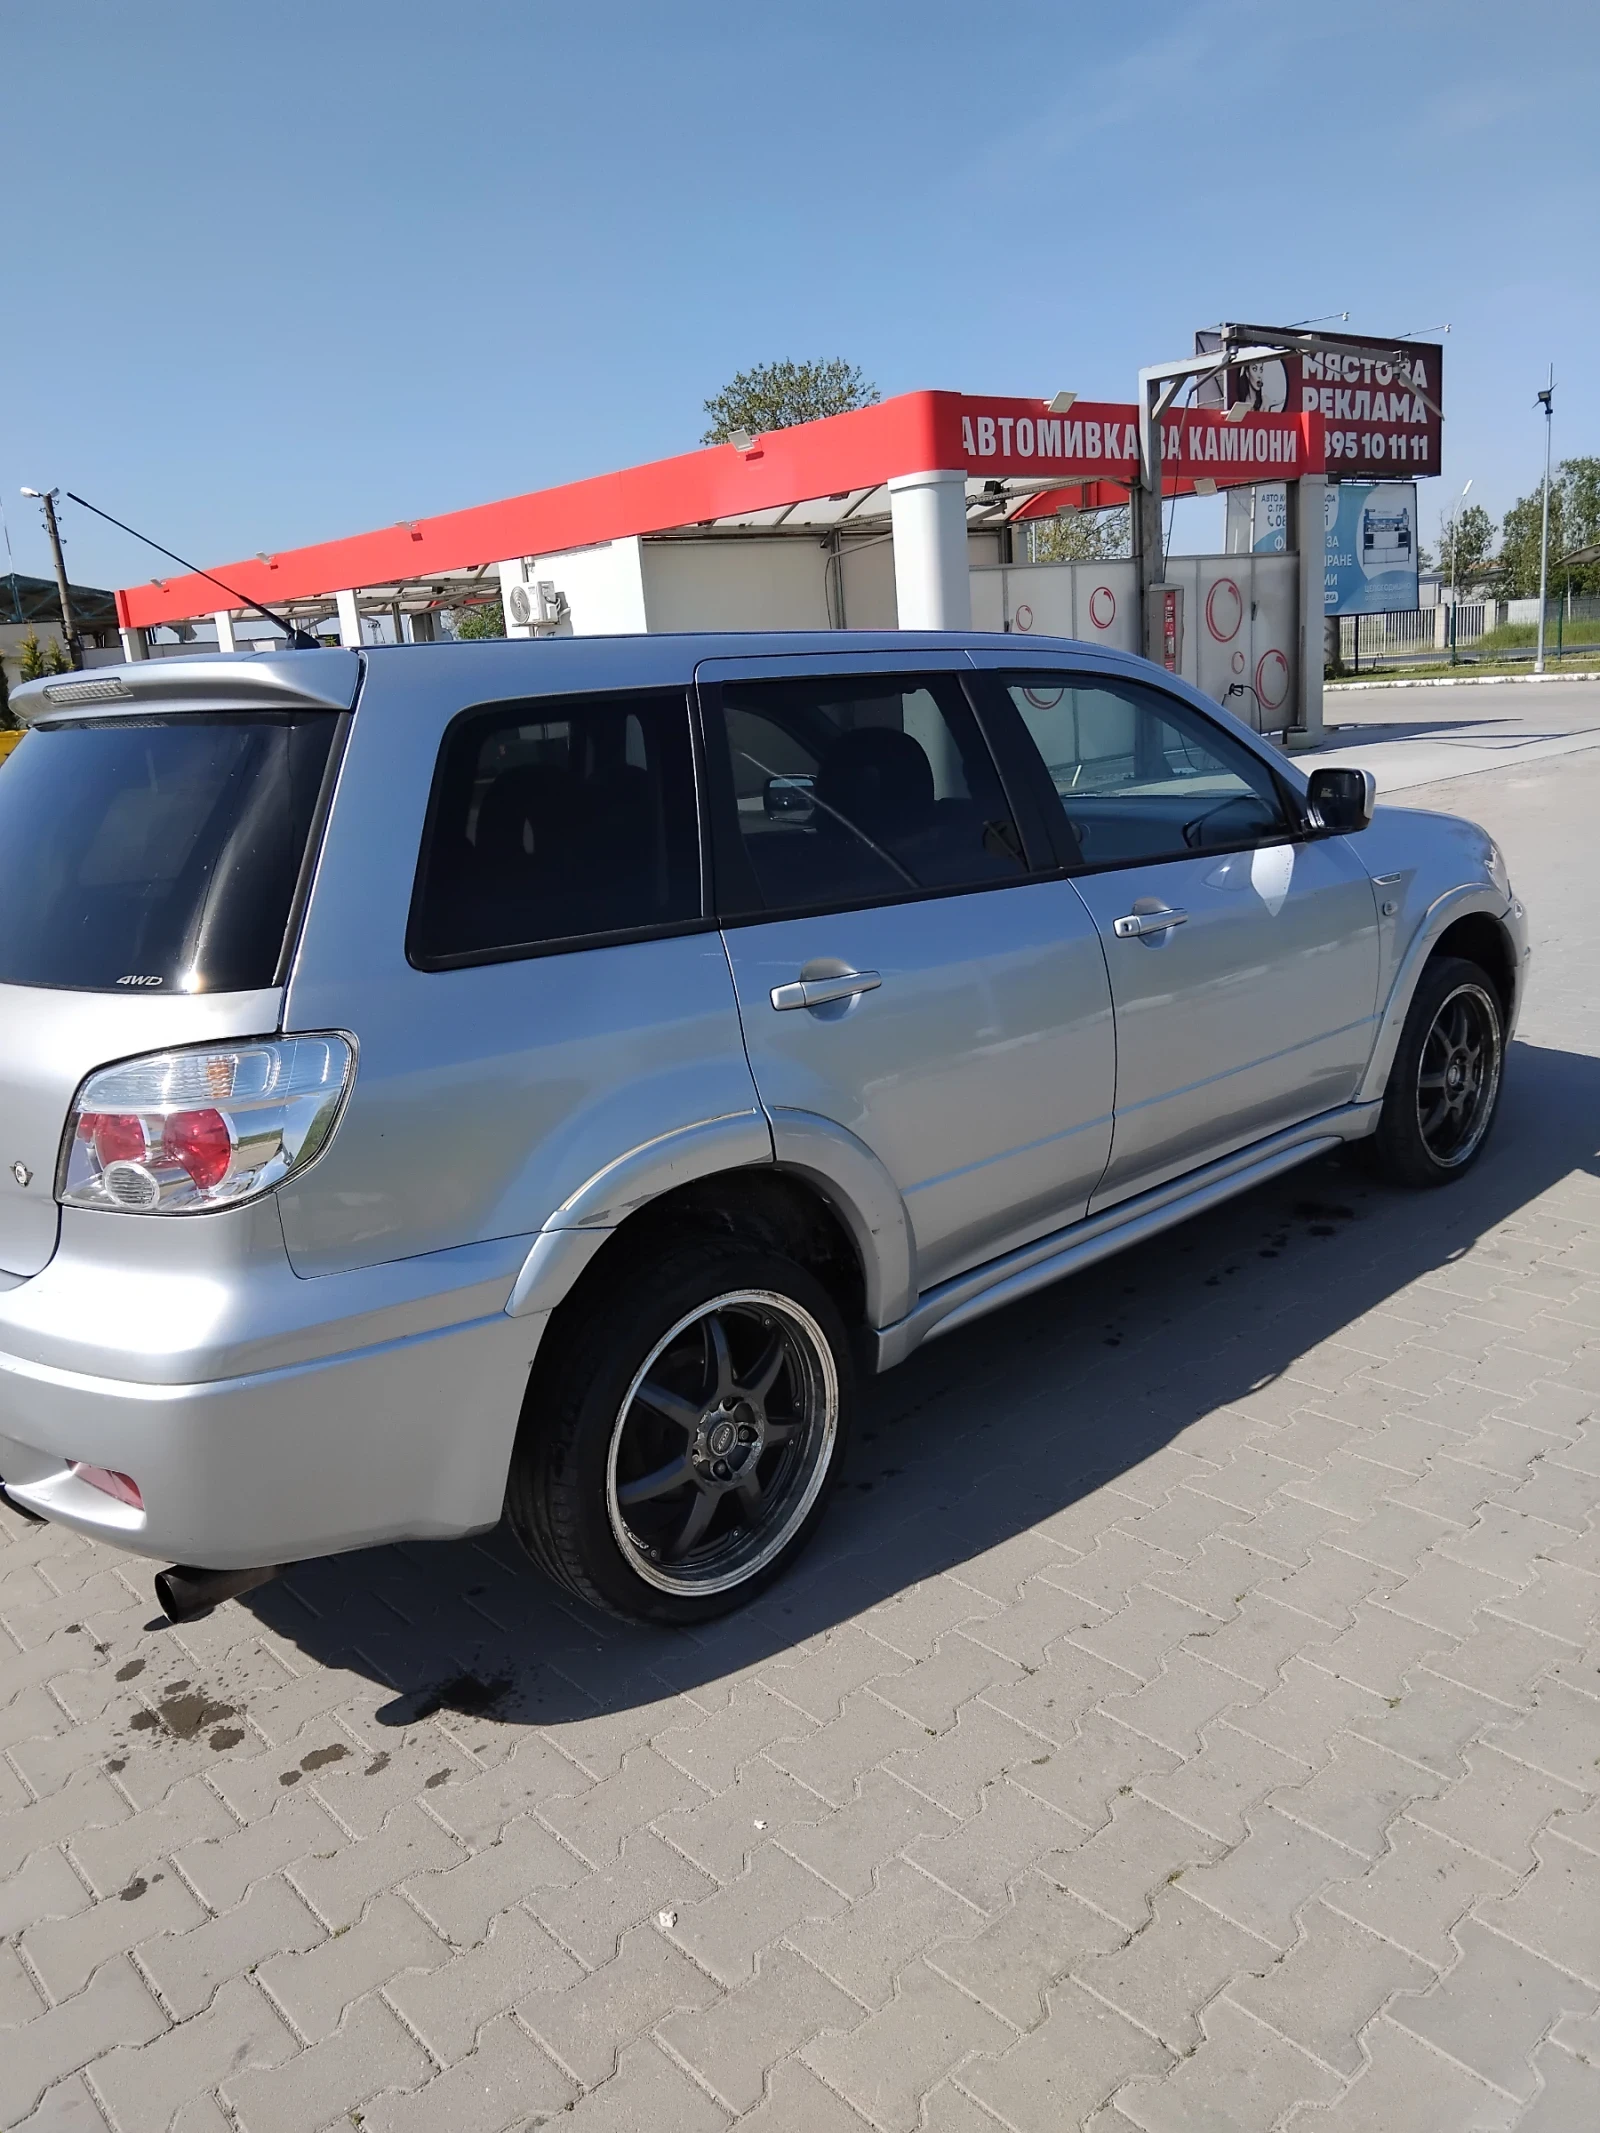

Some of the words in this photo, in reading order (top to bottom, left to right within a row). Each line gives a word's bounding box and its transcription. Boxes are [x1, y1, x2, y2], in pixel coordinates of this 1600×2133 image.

[1302, 352, 1393, 386] МЯСТО
[1302, 387, 1428, 424] РЕКЛАМА
[962, 416, 1139, 460] АВТОМИВКА
[1189, 426, 1297, 463] КАМИОНИ
[1361, 432, 1386, 459] 10
[1388, 434, 1407, 460] 11
[1410, 435, 1428, 460] 11
[1261, 494, 1279, 502] АВТО
[1326, 535, 1339, 548] ЗА
[1324, 554, 1352, 567] РАНЕ
[116, 975, 163, 986] 4WD
